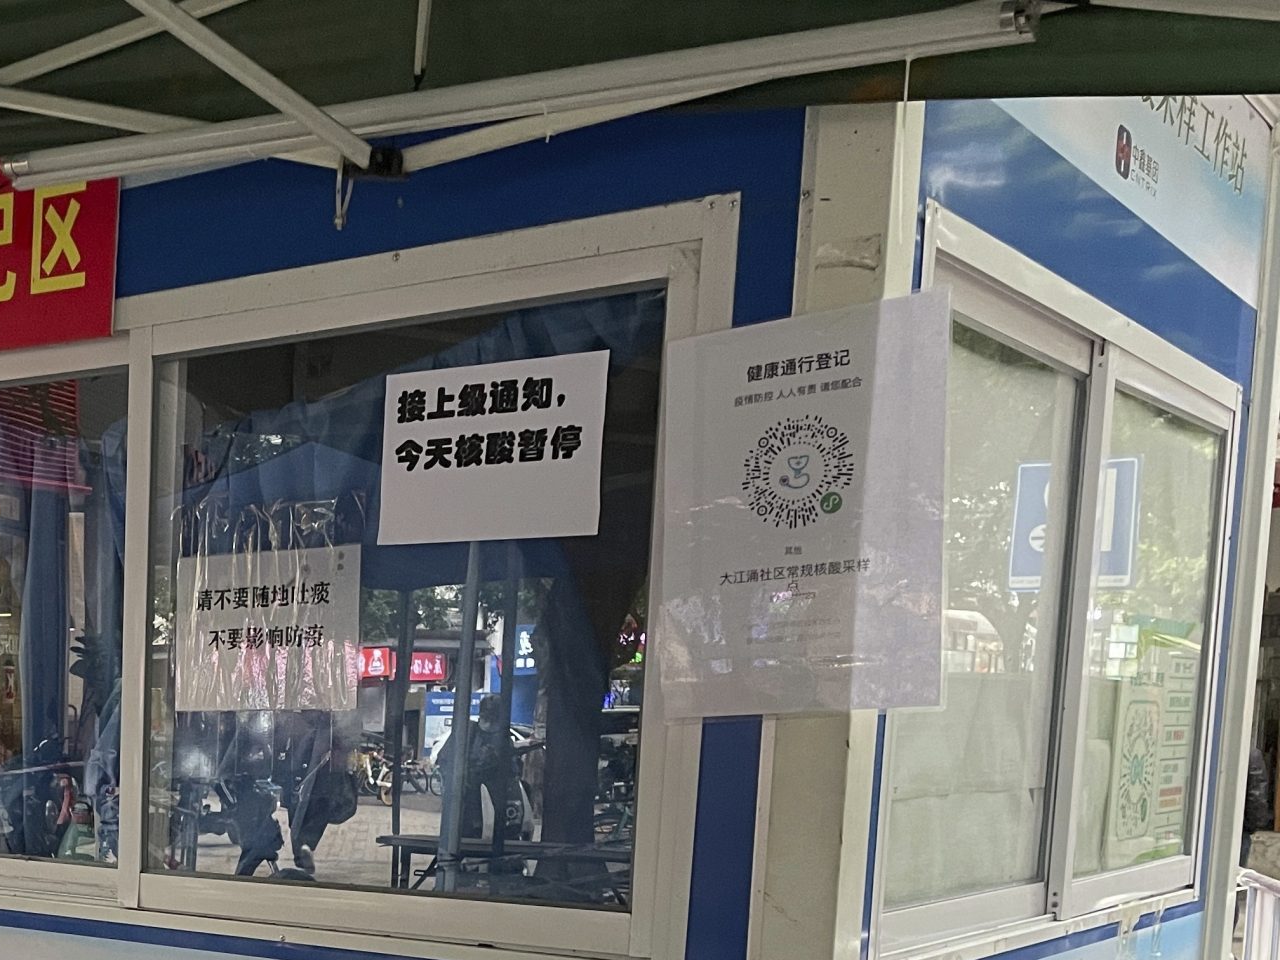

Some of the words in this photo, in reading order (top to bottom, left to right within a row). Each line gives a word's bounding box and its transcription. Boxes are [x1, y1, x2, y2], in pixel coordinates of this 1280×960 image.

[746, 349, 851, 383] 健康通行登记
[734, 390, 773, 408] 疫情防控
[776, 384, 817, 401] 人人有责
[395, 425, 582, 472] 今天核酸暂停
[720, 558, 871, 586] 大江涌社区常规核酸采样
